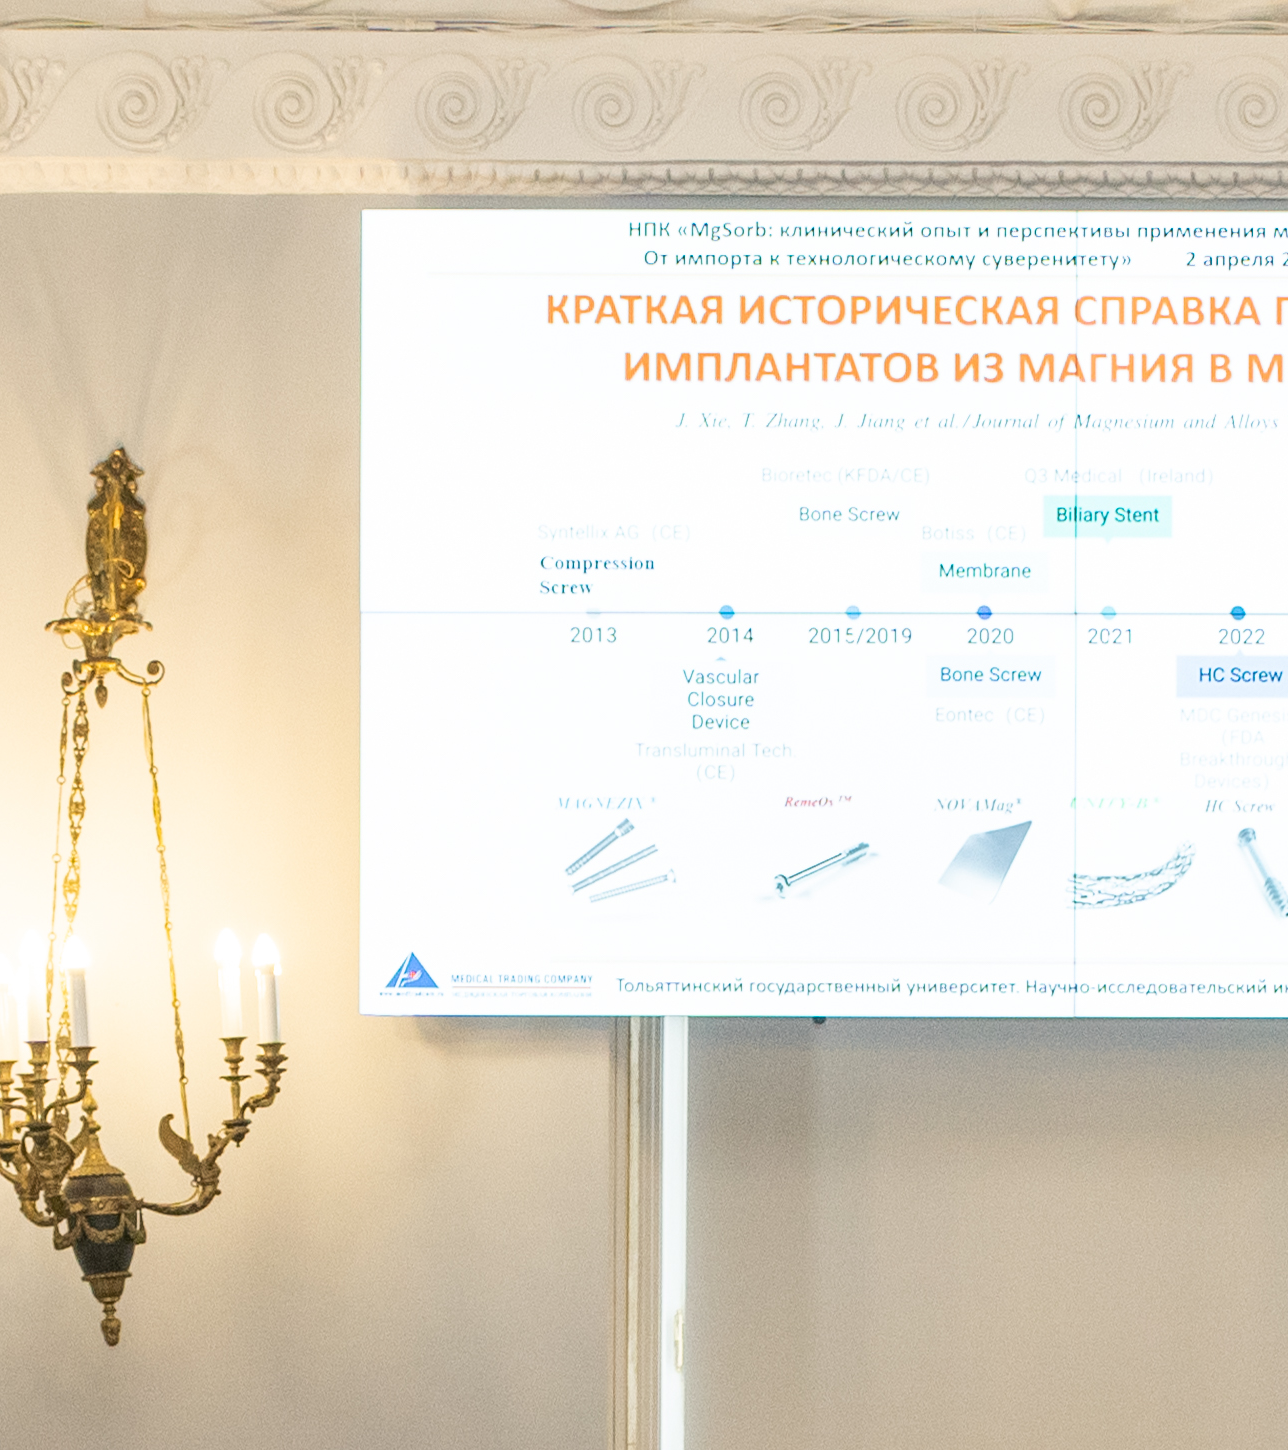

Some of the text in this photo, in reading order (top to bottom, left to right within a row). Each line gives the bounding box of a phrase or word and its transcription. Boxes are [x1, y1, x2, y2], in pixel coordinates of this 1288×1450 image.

[628, 221, 671, 237] НПК
[677, 220, 773, 242] «MgSorb:
[780, 221, 914, 238] клинический
[920, 226, 971, 238] опыт
[978, 226, 990, 238] и
[996, 225, 1130, 242] перспективы
[1137, 226, 1267, 243] применения
[643, 250, 668, 266] От
[675, 253, 763, 270] импорта
[769, 254, 780, 266] к
[787, 253, 976, 271] технологическому
[981, 254, 1132, 271] суверенитету»
[1186, 251, 1196, 267] 2
[1203, 254, 1275, 272] апреля
[547, 294, 723, 325] КРАТКАЯ
[739, 294, 1059, 326] ИСТОРИЧЕСКАЯ
[1074, 295, 1261, 326] СПРАВКА
[624, 352, 939, 384] ИМПЛАНТАТОВ
[954, 352, 1004, 384] ИЗ
[1019, 353, 1193, 383] МАГНИЯ
[1210, 353, 1232, 383] В
[699, 412, 731, 431] Xie,
[765, 412, 826, 432] Zhang,
[856, 412, 906, 432] Jiang
[915, 414, 931, 429] et
[1046, 412, 1067, 432] of
[1073, 413, 1176, 432] Magnesium
[1182, 413, 1217, 430] and
[1225, 413, 1279, 433] Alloys
[799, 506, 901, 522] Bone Screw
[1055, 506, 1161, 528] Biliary Stent
[539, 556, 655, 574] Compression
[938, 562, 1032, 579] Membrane
[539, 580, 594, 595] Screw
[570, 626, 618, 644] 2013
[707, 626, 754, 644] 2014
[808, 626, 913, 645] 2015/2019
[967, 627, 1015, 645] 2020
[1087, 627, 1132, 645] 2021
[1218, 627, 1266, 645] 2022
[682, 668, 760, 685] Vascular
[940, 666, 1043, 683] Bone Screw
[1199, 666, 1284, 683] HC Screw
[687, 690, 755, 708] Closure
[691, 713, 751, 730] Device
[451, 974, 594, 985] MEDICAL TRADING COMPANY
[616, 976, 744, 993] Тольяттинский
[749, 978, 902, 997] государственный
